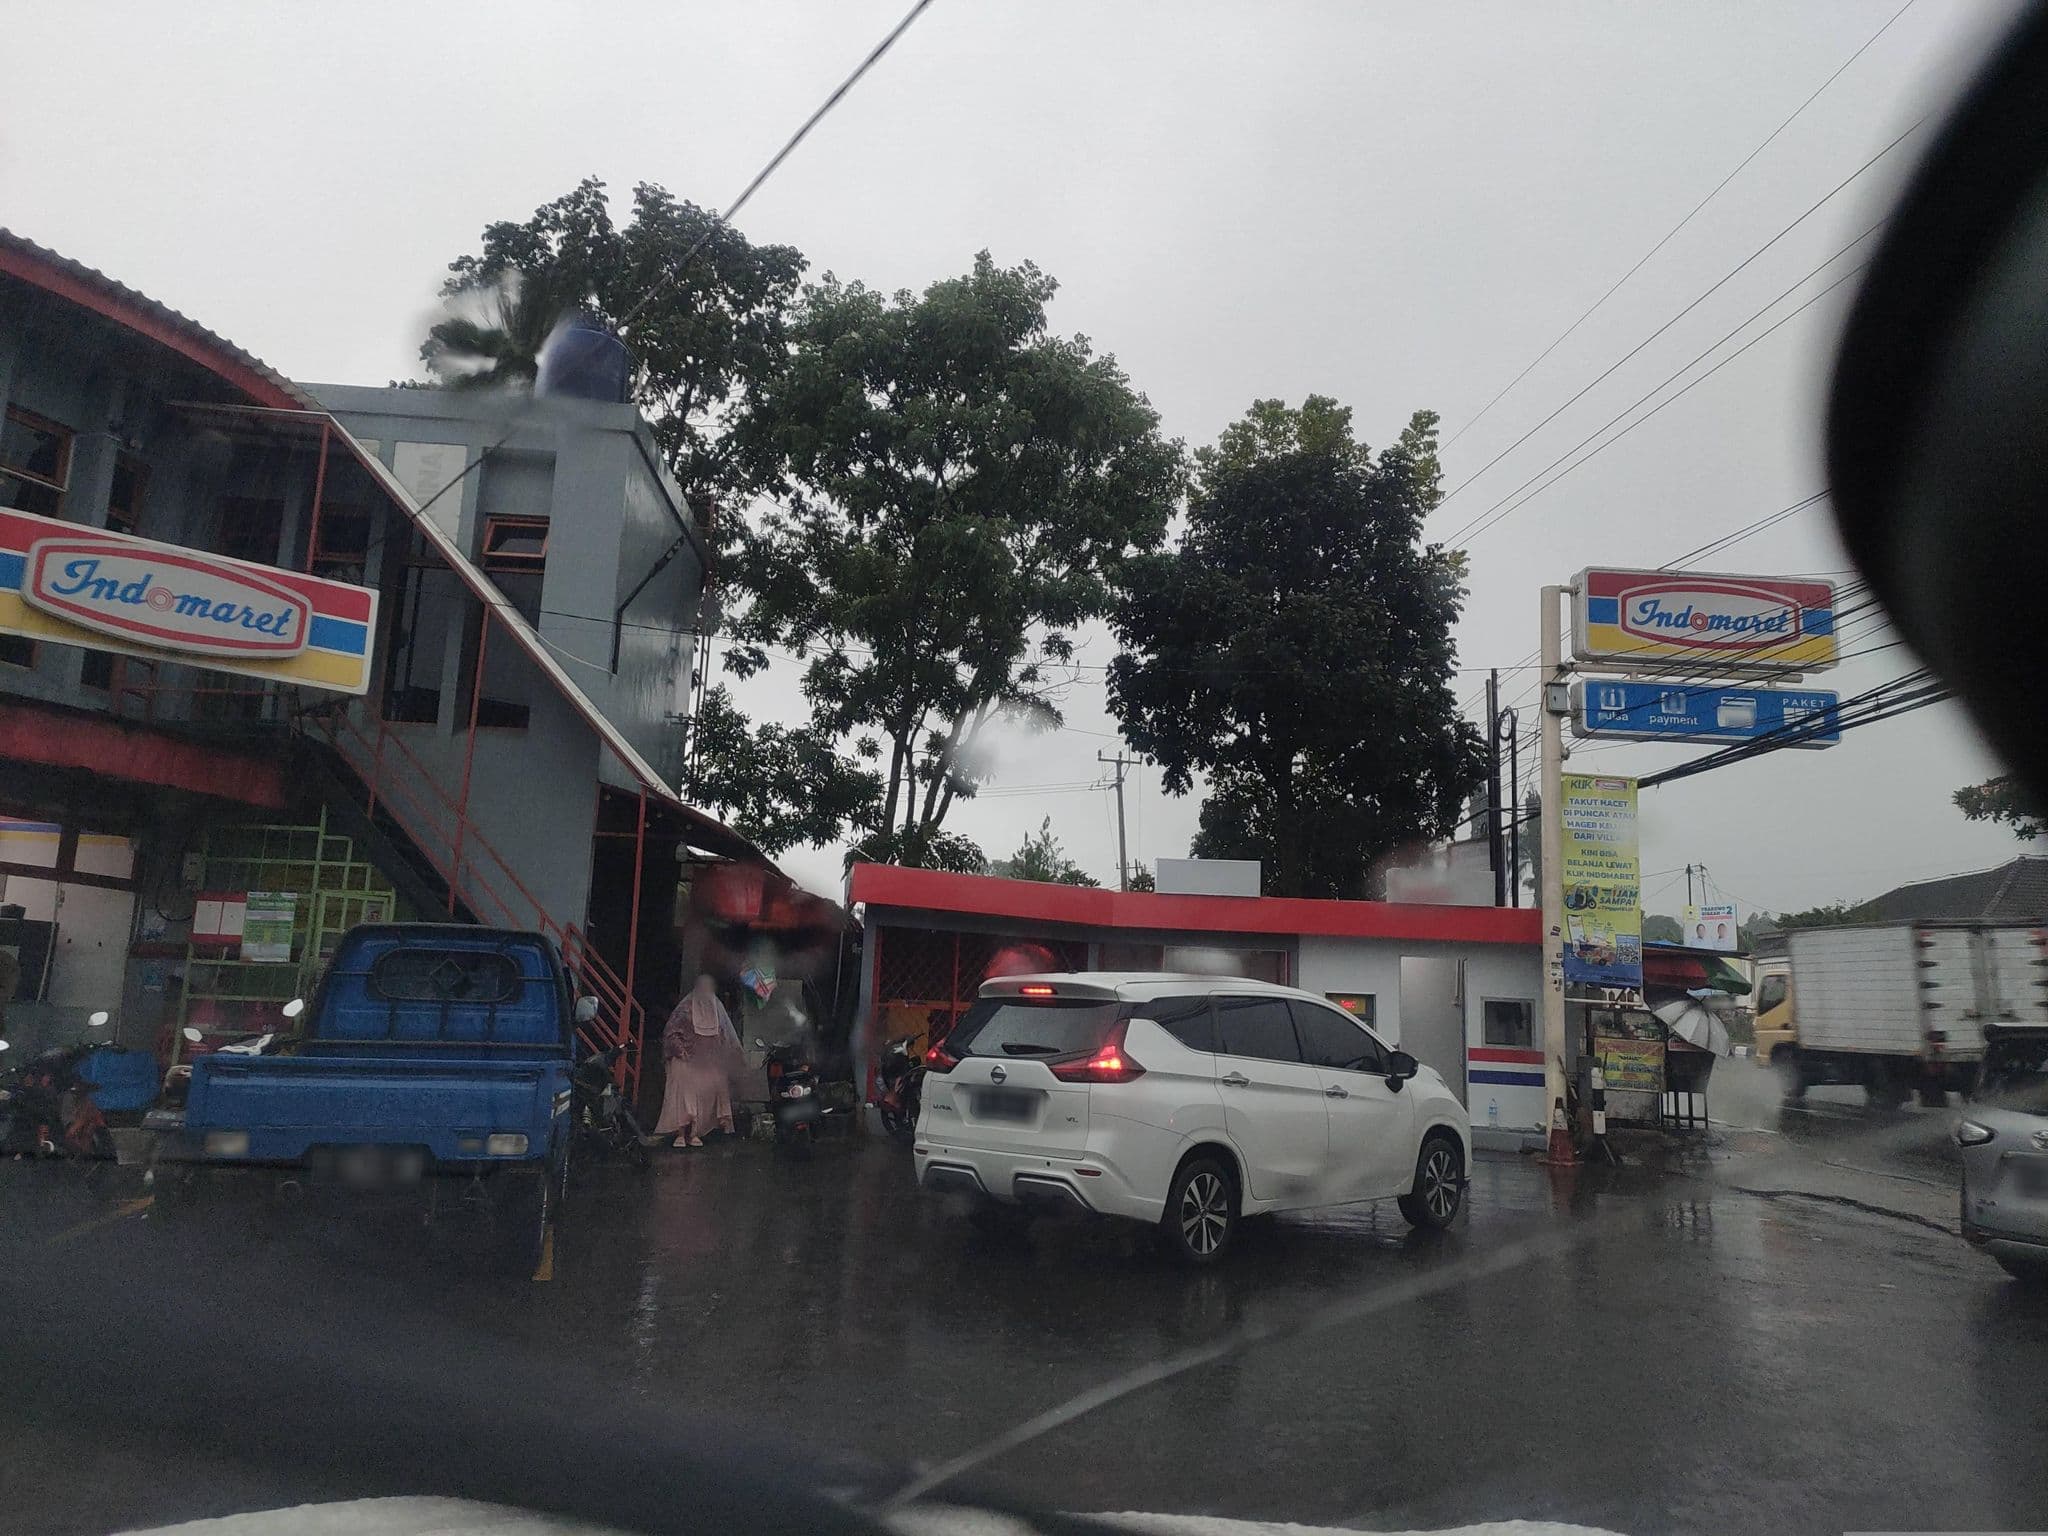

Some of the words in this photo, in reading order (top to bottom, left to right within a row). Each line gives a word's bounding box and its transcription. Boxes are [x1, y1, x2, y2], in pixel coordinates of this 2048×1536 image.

[51, 559, 294, 637] Indomaret
[1631, 599, 1790, 633] Indomaret
[1782, 698, 1826, 708] PAKET
[1649, 713, 1698, 726] payment
[1569, 798, 1599, 806] TAKUT
[1600, 799, 1629, 808] MACET
[1573, 809, 1611, 818] PUNCAK
[1573, 832, 1595, 841] DARI
[1567, 859, 1605, 868] BELANJA
[1605, 861, 1633, 870] LEWAT
[1566, 869, 1586, 877] KLIK
[1586, 871, 1636, 881] INDOMARET
[1599, 896, 1637, 907] SAMPAI
[1726, 906, 1732, 914] 2
